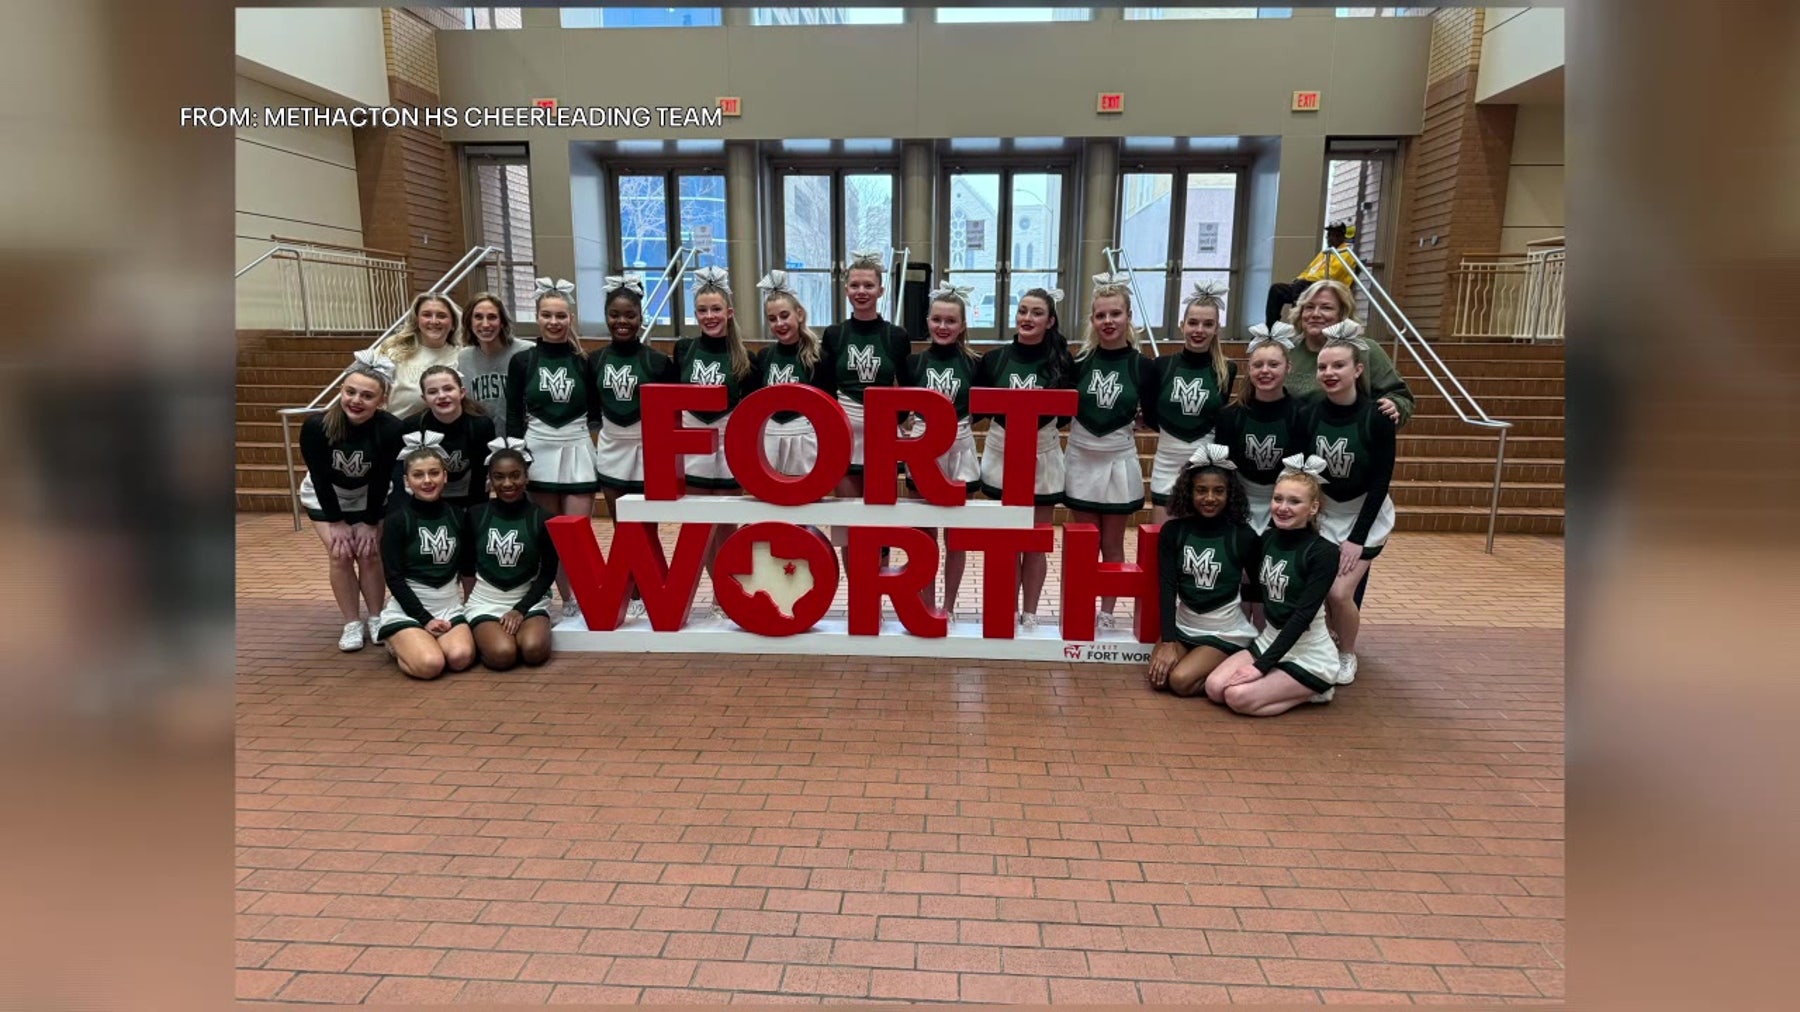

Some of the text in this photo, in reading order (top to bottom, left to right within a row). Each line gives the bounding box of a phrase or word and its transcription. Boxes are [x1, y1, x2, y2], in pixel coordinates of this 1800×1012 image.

[1102, 95, 1120, 110] EXIT
[1298, 94, 1316, 108] EXIT
[641, 383, 1078, 507] FORT
[546, 515, 1160, 643] WORTH
[1088, 651, 1151, 662] FORT WOR
